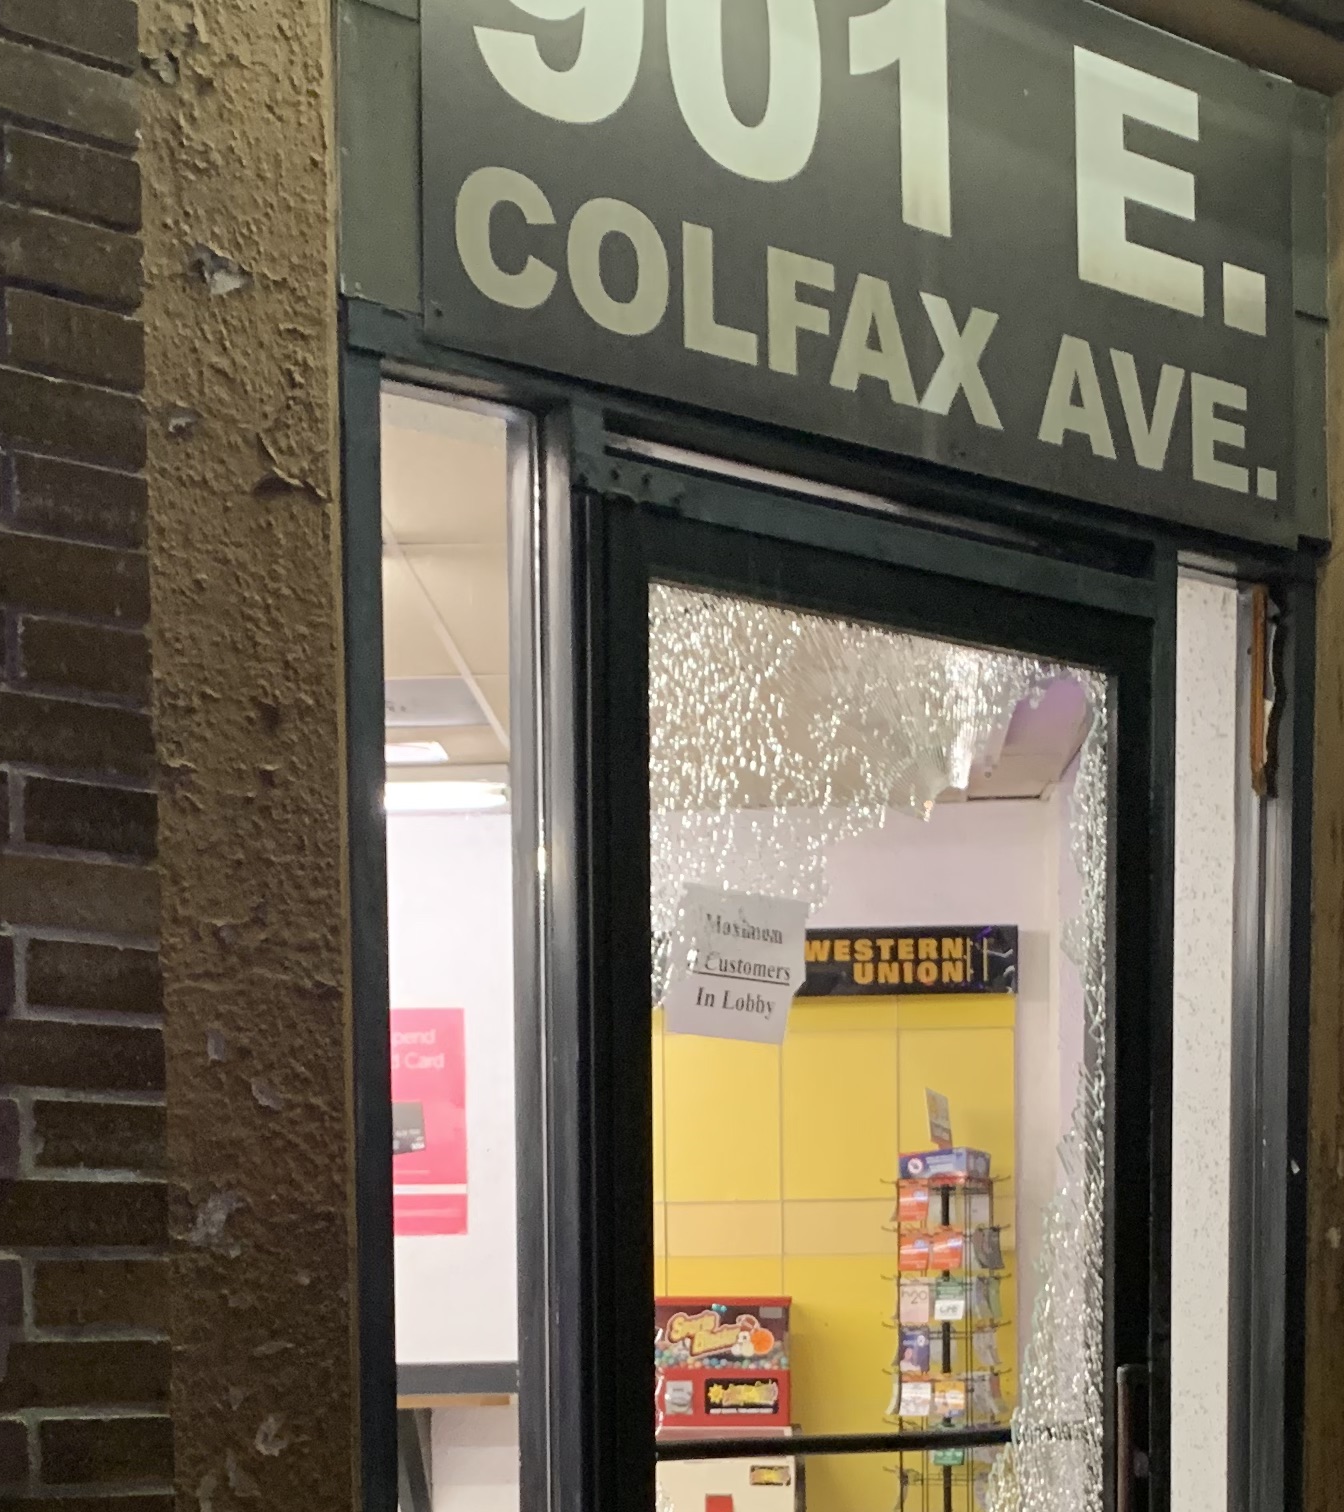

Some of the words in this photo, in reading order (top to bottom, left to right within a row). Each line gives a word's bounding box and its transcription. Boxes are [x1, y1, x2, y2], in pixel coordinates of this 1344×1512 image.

[1072, 44, 1267, 337] E.
[454, 166, 1004, 431] COLFAX
[1038, 334, 1278, 500] AVE.
[804, 937, 964, 962] WESTERN
[705, 951, 791, 981] Customers
[853, 960, 964, 985] UNION
[695, 986, 715, 1008] In
[722, 989, 775, 1020] Lobby
[392, 1029, 437, 1047] pend
[404, 1052, 445, 1070] Card
